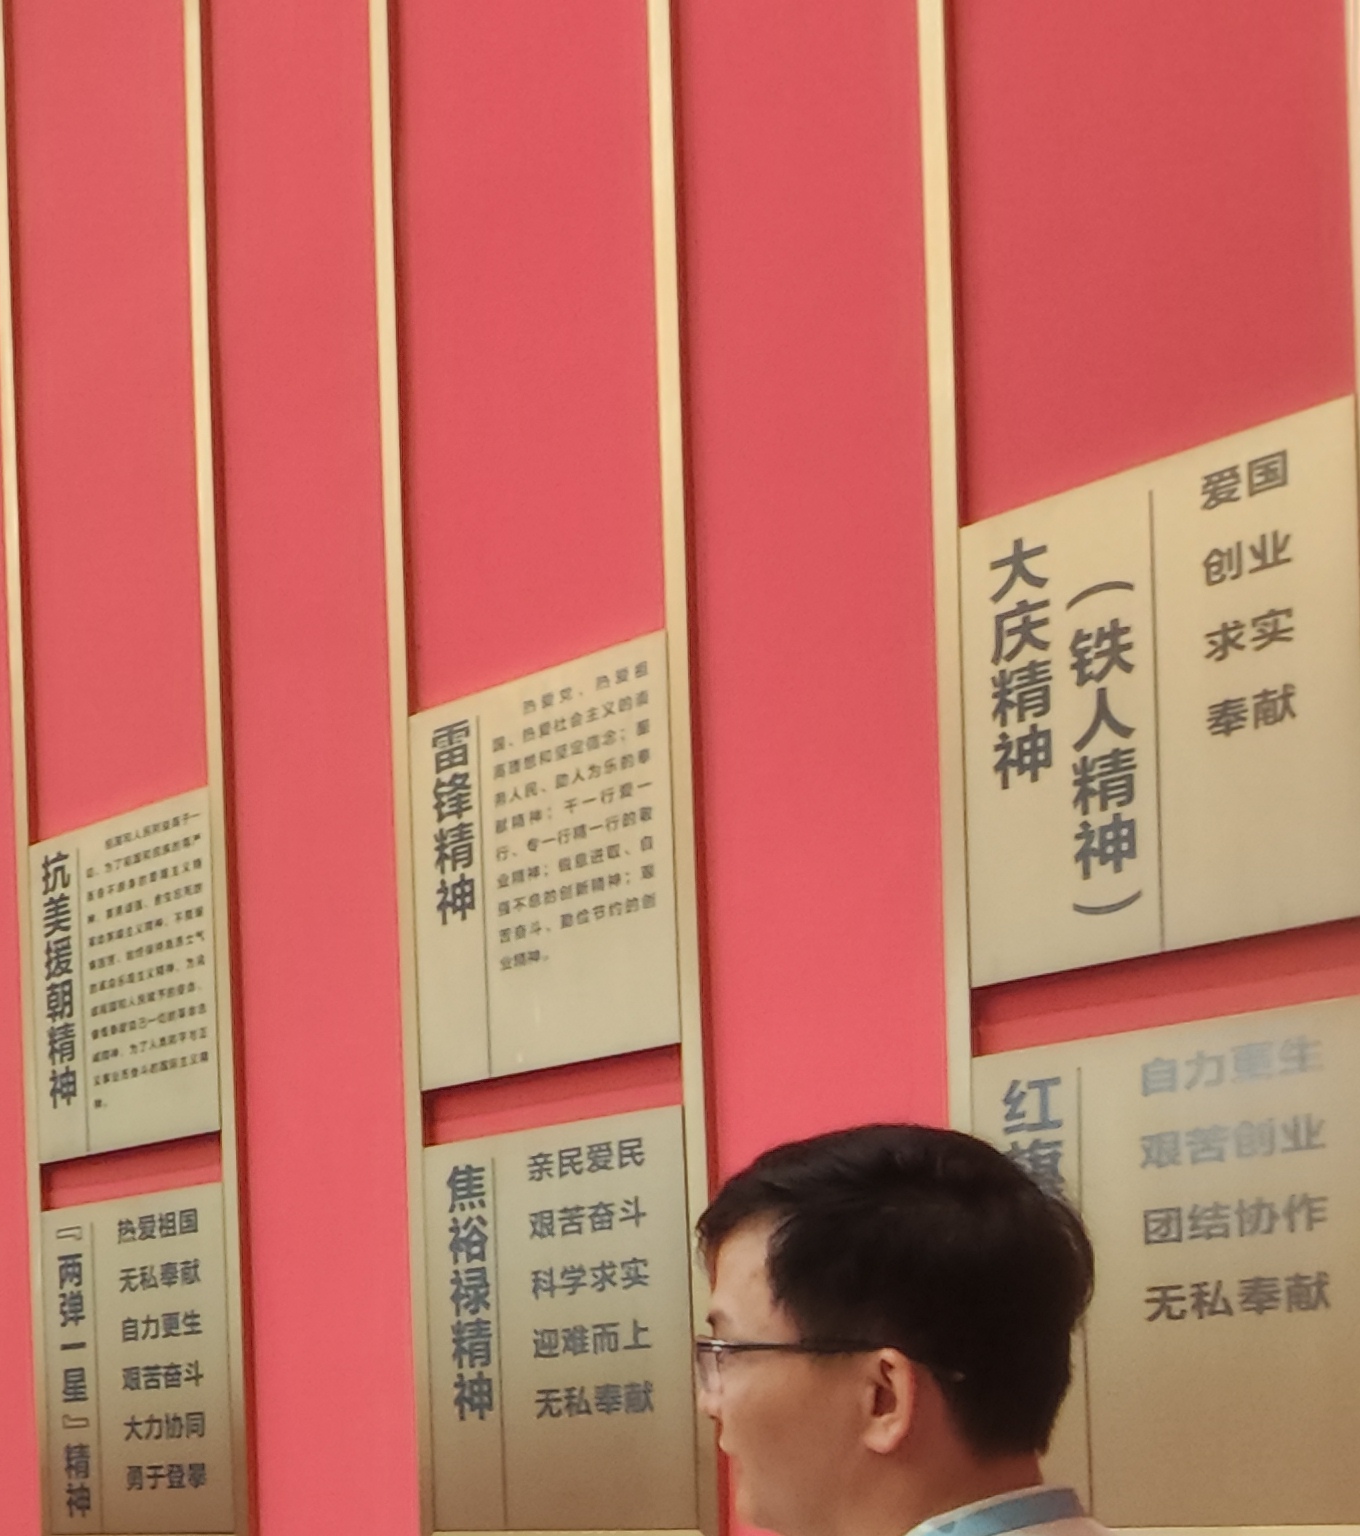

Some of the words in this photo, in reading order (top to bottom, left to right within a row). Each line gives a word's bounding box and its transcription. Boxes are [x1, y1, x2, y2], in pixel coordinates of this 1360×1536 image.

[1200, 450, 1289, 512] 爱国
[1202, 529, 1293, 587] 创业
[1204, 607, 1296, 663] 求实
[989, 537, 1054, 790] 大庆精神
[1206, 682, 1298, 739] 奉献
[431, 718, 477, 926] 雷锋精神
[41, 850, 78, 1109] 抗美援朝精神
[1139, 1034, 1325, 1098] 自力更生
[526, 1136, 646, 1183] 亲民爱民
[1139, 1112, 1328, 1170] 艰苦创业
[116, 1207, 199, 1245] 热爱祖国
[528, 1195, 648, 1240] 艰苦奋斗
[1142, 1193, 1330, 1246] 团结协作
[118, 1258, 202, 1293] 无私奉献
[446, 1163, 494, 1421] 焦裕禄精神
[531, 1256, 650, 1300] 科学求实
[1144, 1269, 1332, 1323] 无私奉献
[121, 1309, 204, 1343] 自力更生
[533, 1319, 652, 1359] 迎难而上
[121, 1360, 204, 1391] 艰苦奋斗
[534, 1381, 655, 1420] 无私奉献
[123, 1411, 206, 1442] 大力协同
[126, 1463, 207, 1492] 勇于登攀
